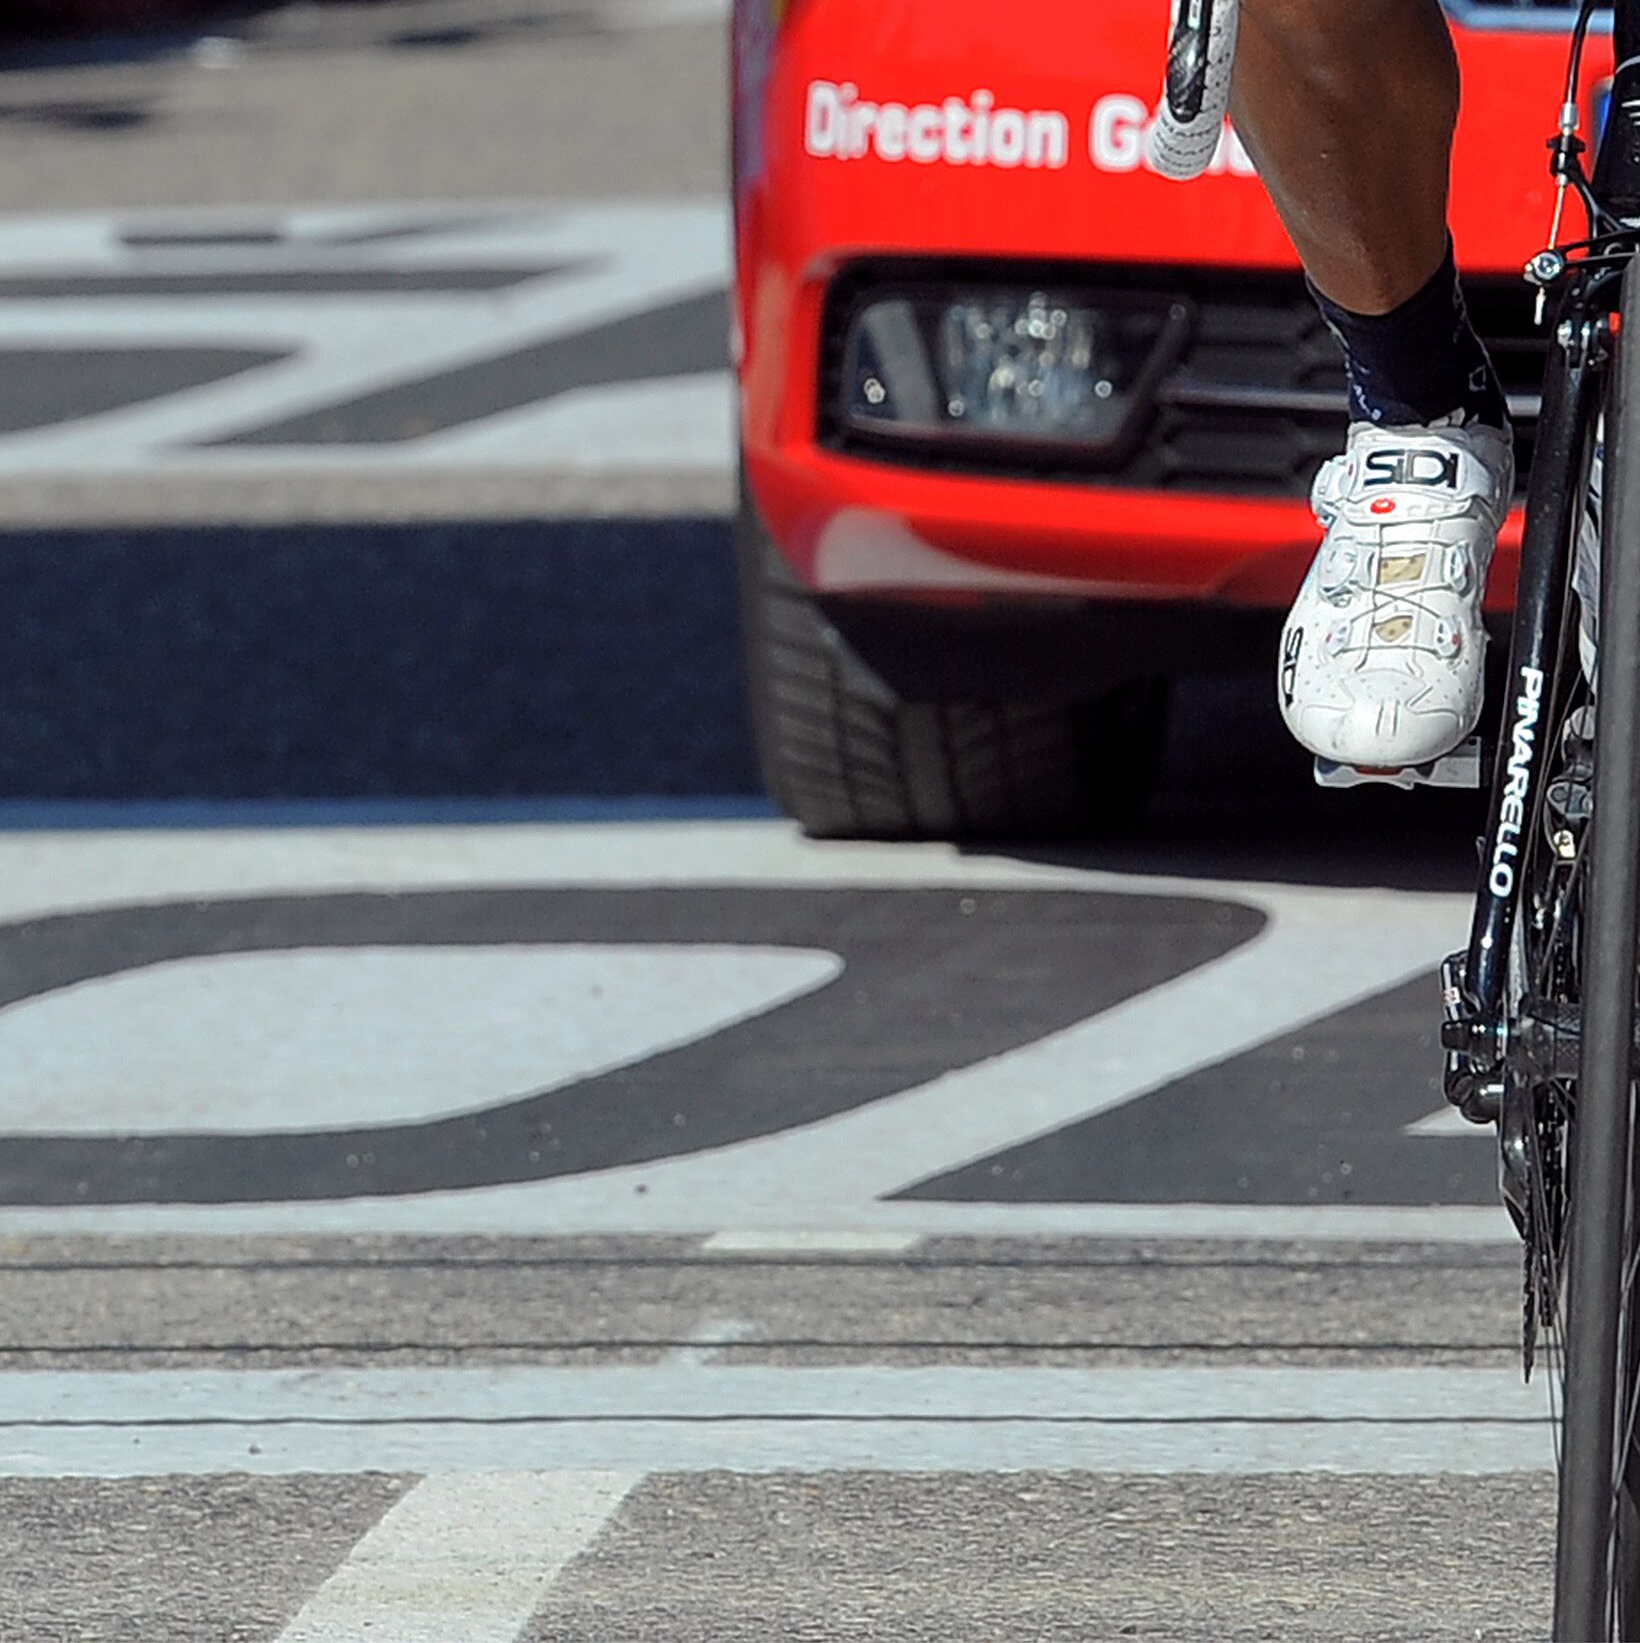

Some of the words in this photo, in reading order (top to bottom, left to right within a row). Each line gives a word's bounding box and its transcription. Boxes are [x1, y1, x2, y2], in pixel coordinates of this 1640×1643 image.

[805, 81, 1068, 168] Direction
[1363, 448, 1459, 488] SIDI
[1489, 666, 1544, 898] PINARELLO
